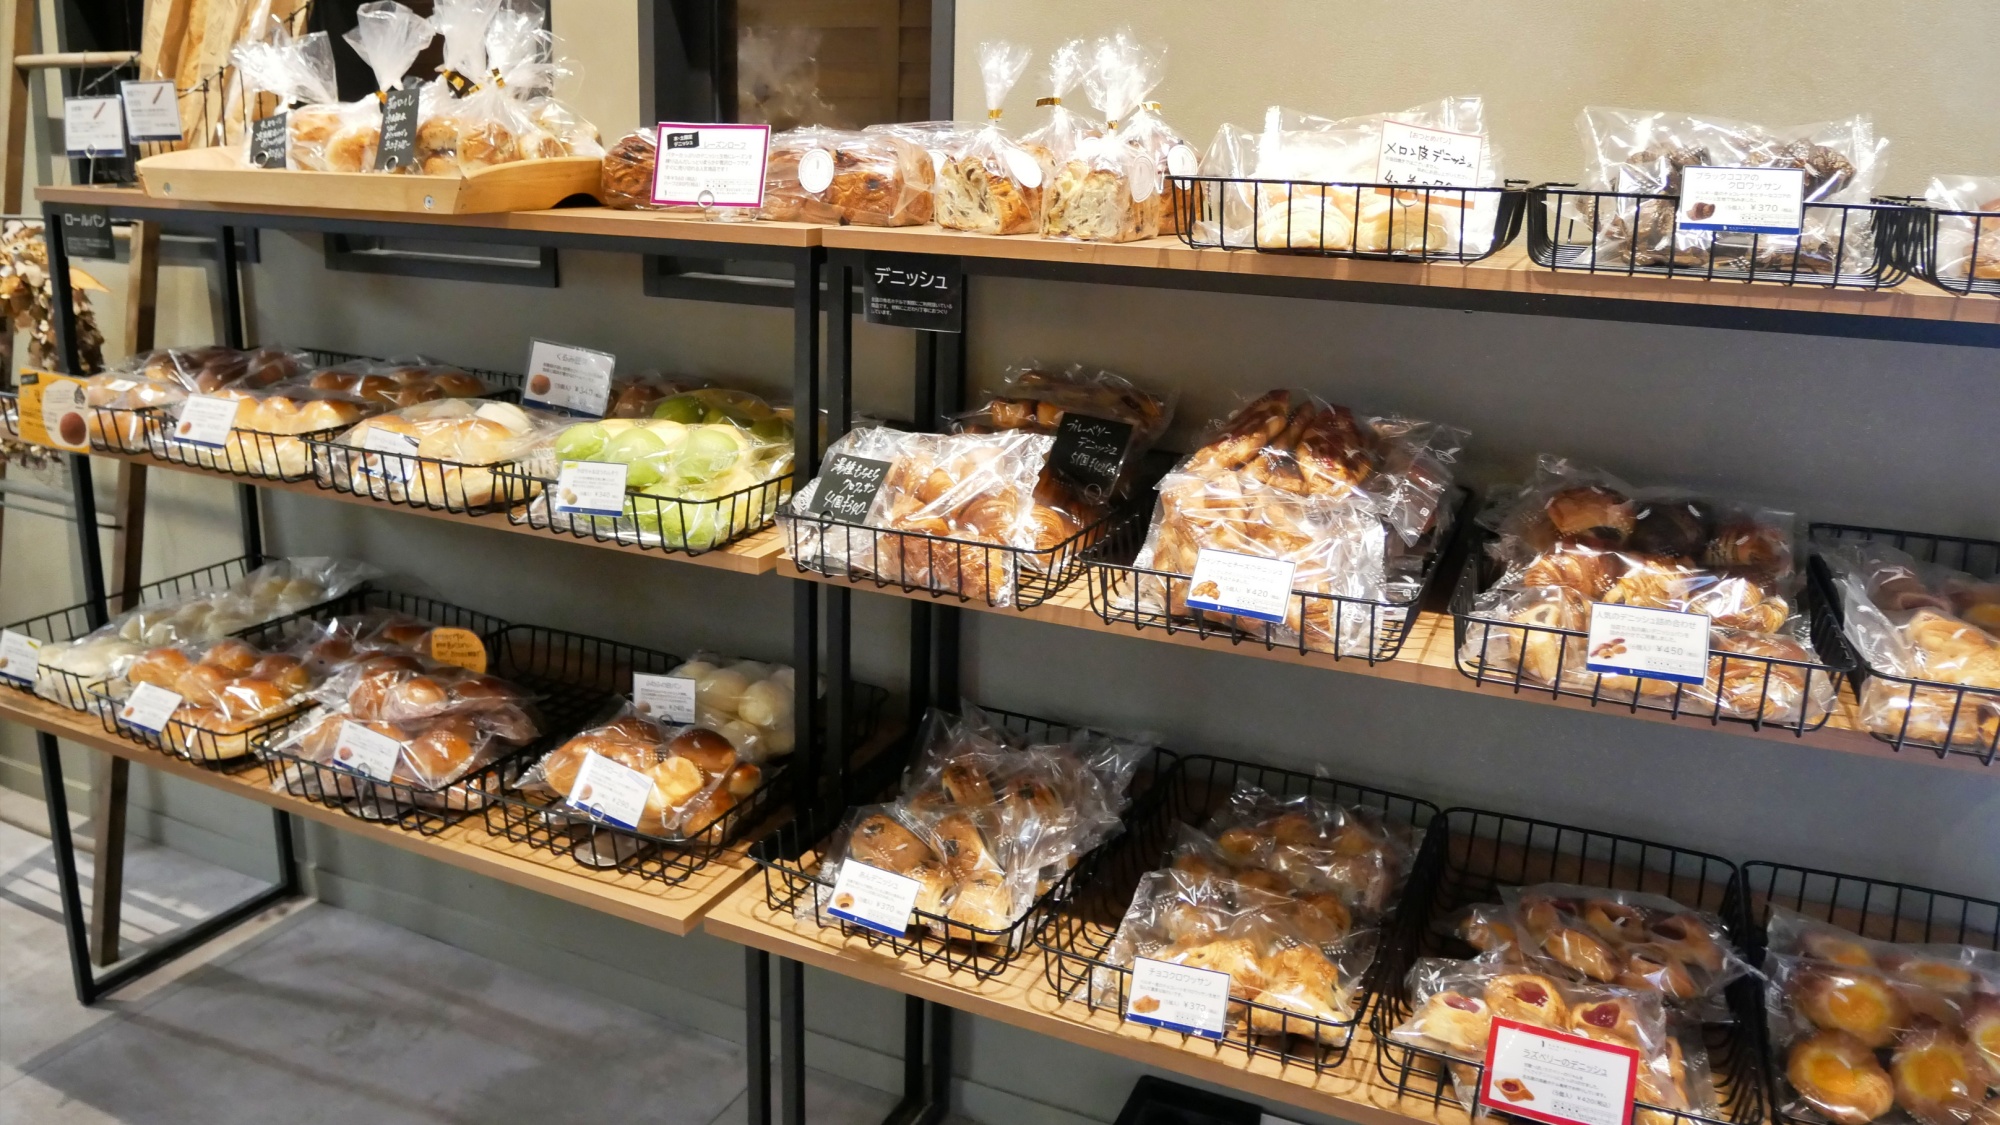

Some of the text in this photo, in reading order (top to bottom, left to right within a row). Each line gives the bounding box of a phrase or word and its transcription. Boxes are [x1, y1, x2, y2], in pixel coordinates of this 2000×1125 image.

[704, 141, 746, 149] レーズンローフ
[1696, 172, 1759, 180] ブラックココアの
[1728, 182, 1782, 190] クロワッサン
[1750, 204, 1778, 212] ¥370
[65, 213, 106, 228] ロールパン
[874, 267, 948, 290] デニッシュ
[1066, 419, 1112, 437] ブルーベリー
[1078, 436, 1118, 456] デニッシュ
[1246, 588, 1268, 598] ¥420
[1596, 611, 1696, 630] 人気のデニッシュ詰め合わせ
[1656, 645, 1684, 656] ¥450
[876, 902, 894, 912] ¥370
[1148, 968, 1212, 986] チョコクロワッサン
[1522, 1048, 1608, 1076] ラズベリーのデニッシュ
